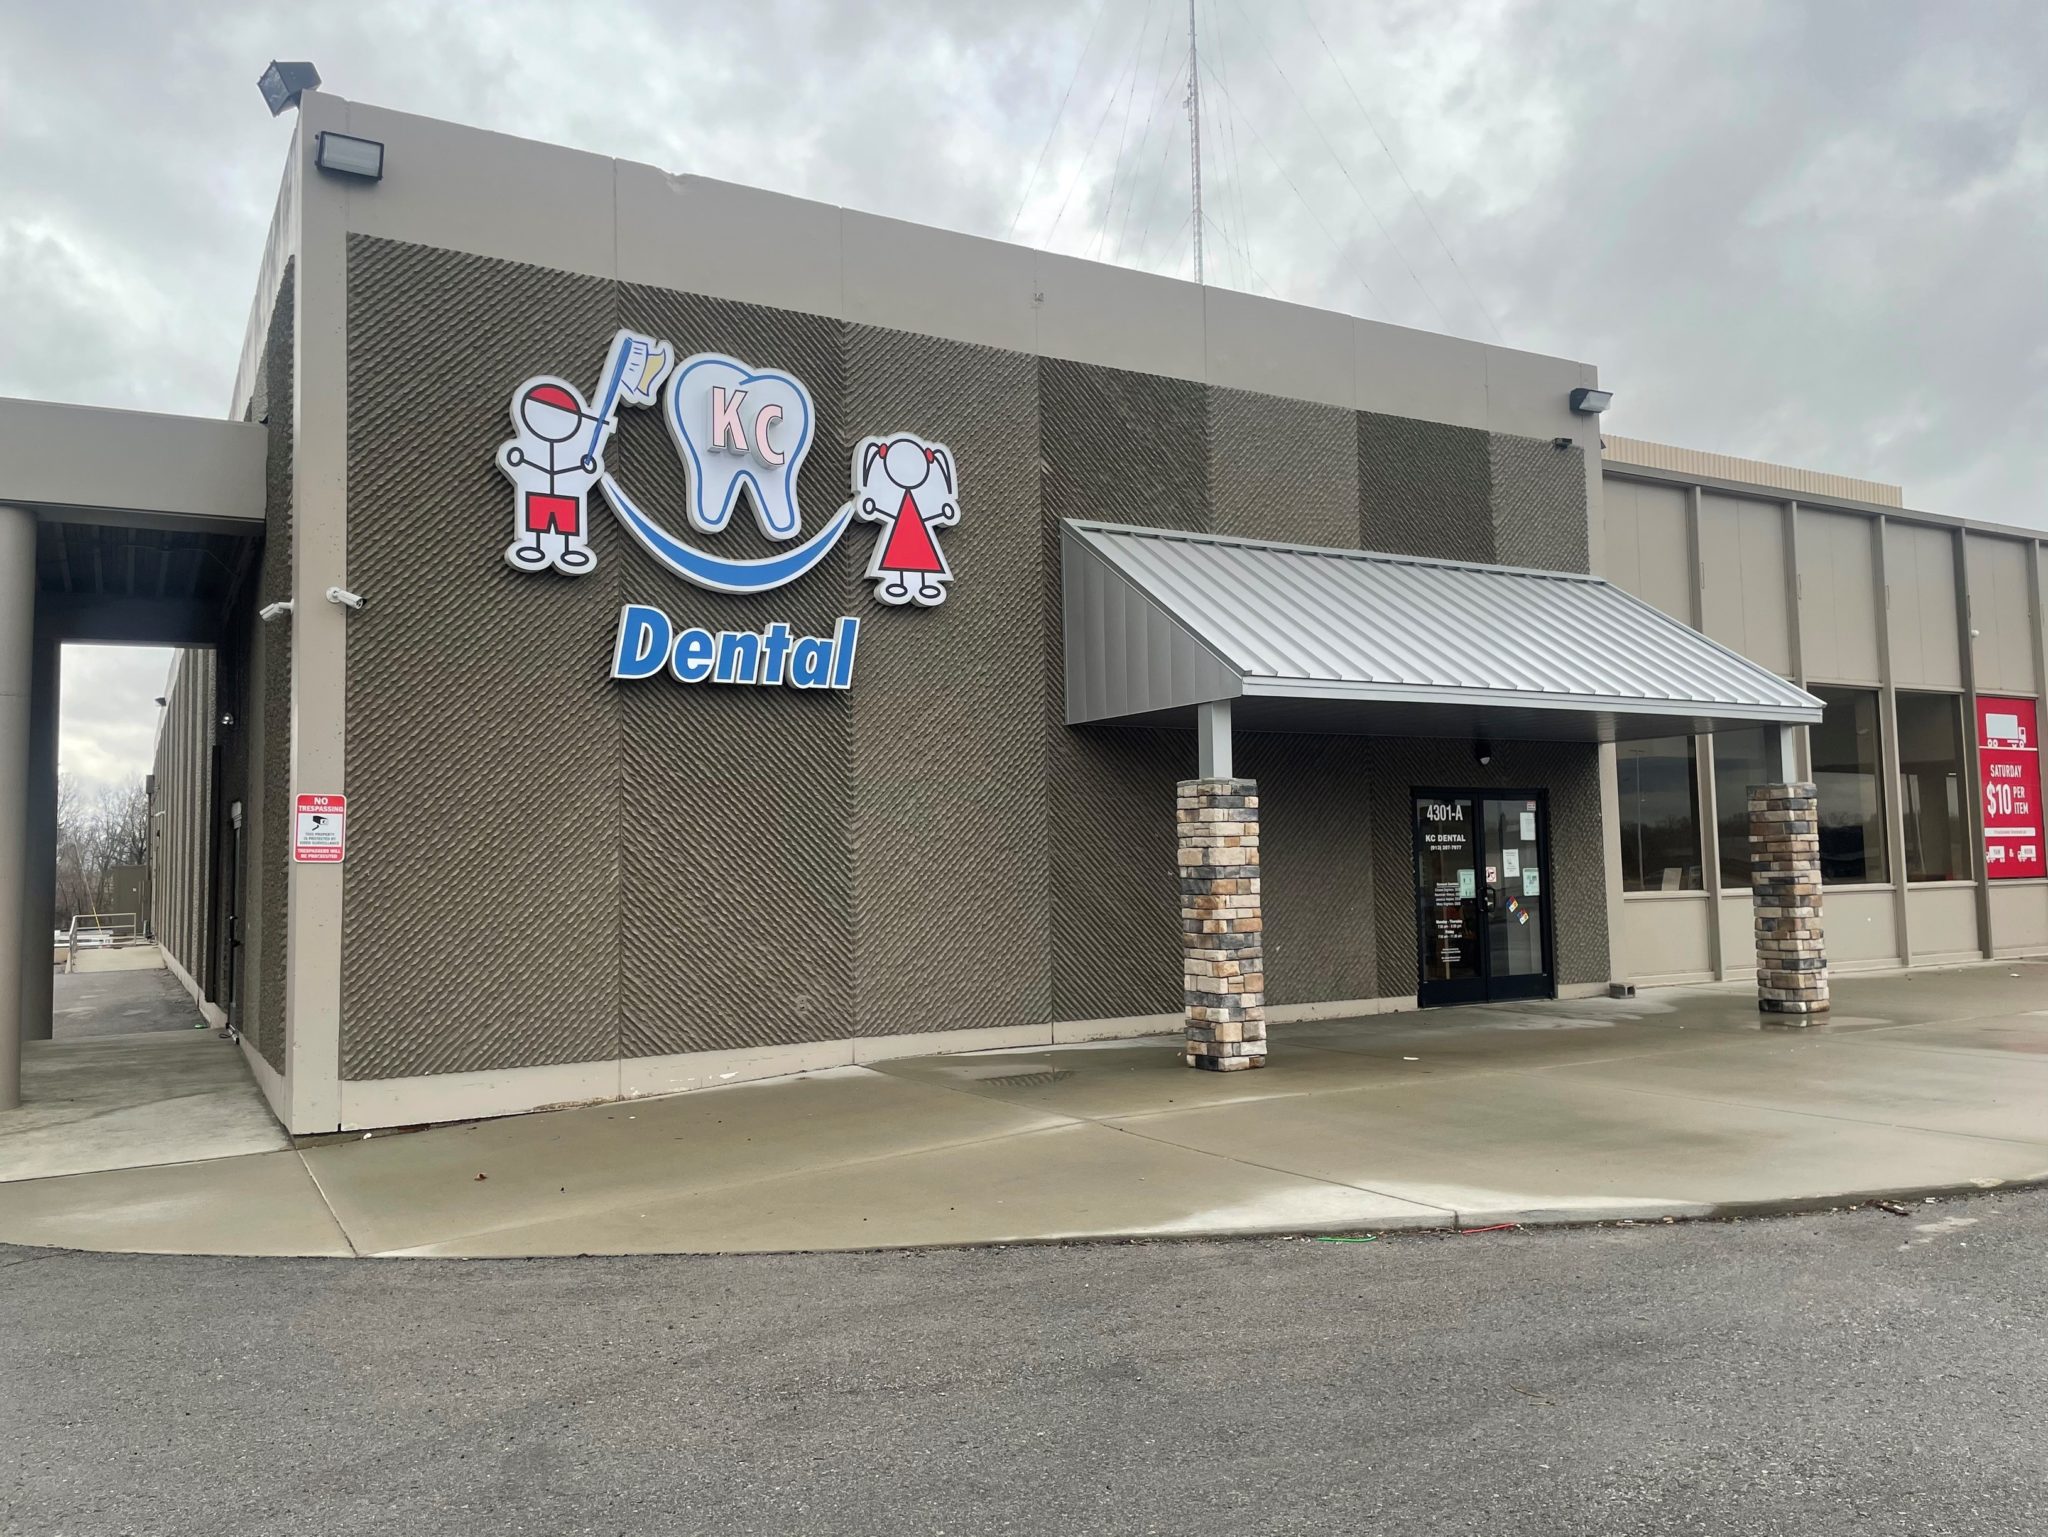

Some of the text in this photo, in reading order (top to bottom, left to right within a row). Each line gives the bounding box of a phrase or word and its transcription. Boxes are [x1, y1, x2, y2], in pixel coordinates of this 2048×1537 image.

[709, 385, 786, 469] KC
[612, 603, 860, 690] Dental
[1990, 764, 2022, 778] SATURDAY
[2013, 786, 2025, 799] PER
[313, 797, 328, 805] NO
[1986, 781, 2012, 818] $10
[298, 805, 344, 813] TRESPASSING
[1426, 804, 1463, 821] 4301-A
[2014, 802, 2029, 815] ITEM
[1425, 834, 1467, 842] KC DENTAL
